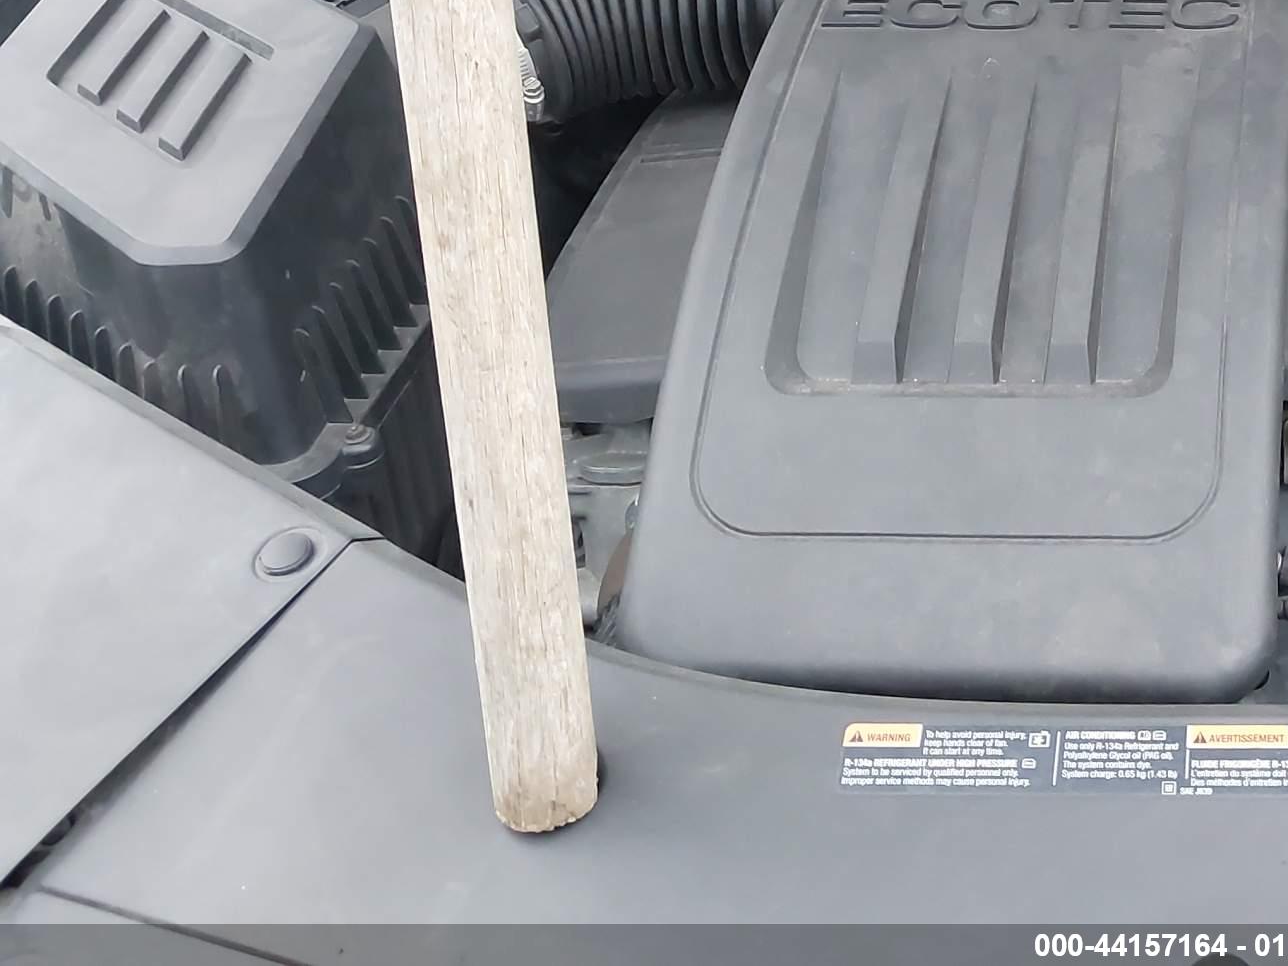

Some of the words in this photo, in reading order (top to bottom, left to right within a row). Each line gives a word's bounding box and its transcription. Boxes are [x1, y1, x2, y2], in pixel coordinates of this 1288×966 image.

[867, 733, 911, 742] WARNING
[926, 730, 934, 738] To
[936, 730, 950, 740] help
[952, 731, 972, 739] avoid
[973, 731, 1003, 739] personal
[1005, 731, 1026, 740] injury.
[1065, 731, 1079, 739] AIR
[1209, 734, 1285, 743] AVERTISSEMENT
[943, 739, 965, 747] hands
[967, 739, 984, 747] clear
[986, 739, 993, 747] of
[995, 739, 1008, 747] fan.
[1064, 742, 1078, 750] Use
[1079, 742, 1094, 751] only
[1096, 742, 1123, 750] R-134a
[1124, 742, 1163, 751] Refrigerant
[1165, 742, 1179, 750] and
[923, 747, 928, 755] It
[944, 747, 960, 755] start
[1109, 752, 1131, 760] Glycol
[1143, 752, 1159, 760] (PAG
[844, 758, 872, 767] R-134a
[874, 758, 927, 767] REFRIGERANT
[928, 759, 955, 768] UNDER
[1078, 761, 1104, 770] system
[1105, 761, 1135, 769] contains
[1137, 761, 1152, 770] dye.
[843, 768, 870, 777] System
[871, 768, 878, 776] to
[880, 768, 890, 776] be
[891, 768, 921, 776] serviced
[923, 768, 932, 777] by
[933, 769, 964, 777] qualified
[966, 769, 1001, 777] personnel
[1002, 769, 1018, 778] only.
[1062, 770, 1089, 779] System
[1090, 770, 1117, 779] charge:
[1118, 770, 1135, 778] 0.65
[1136, 770, 1146, 779] kg
[1147, 770, 1166, 779] (1.43
[841, 777, 873, 786] Improper
[936, 778, 952, 786] may
[976, 778, 1007, 787] personal
